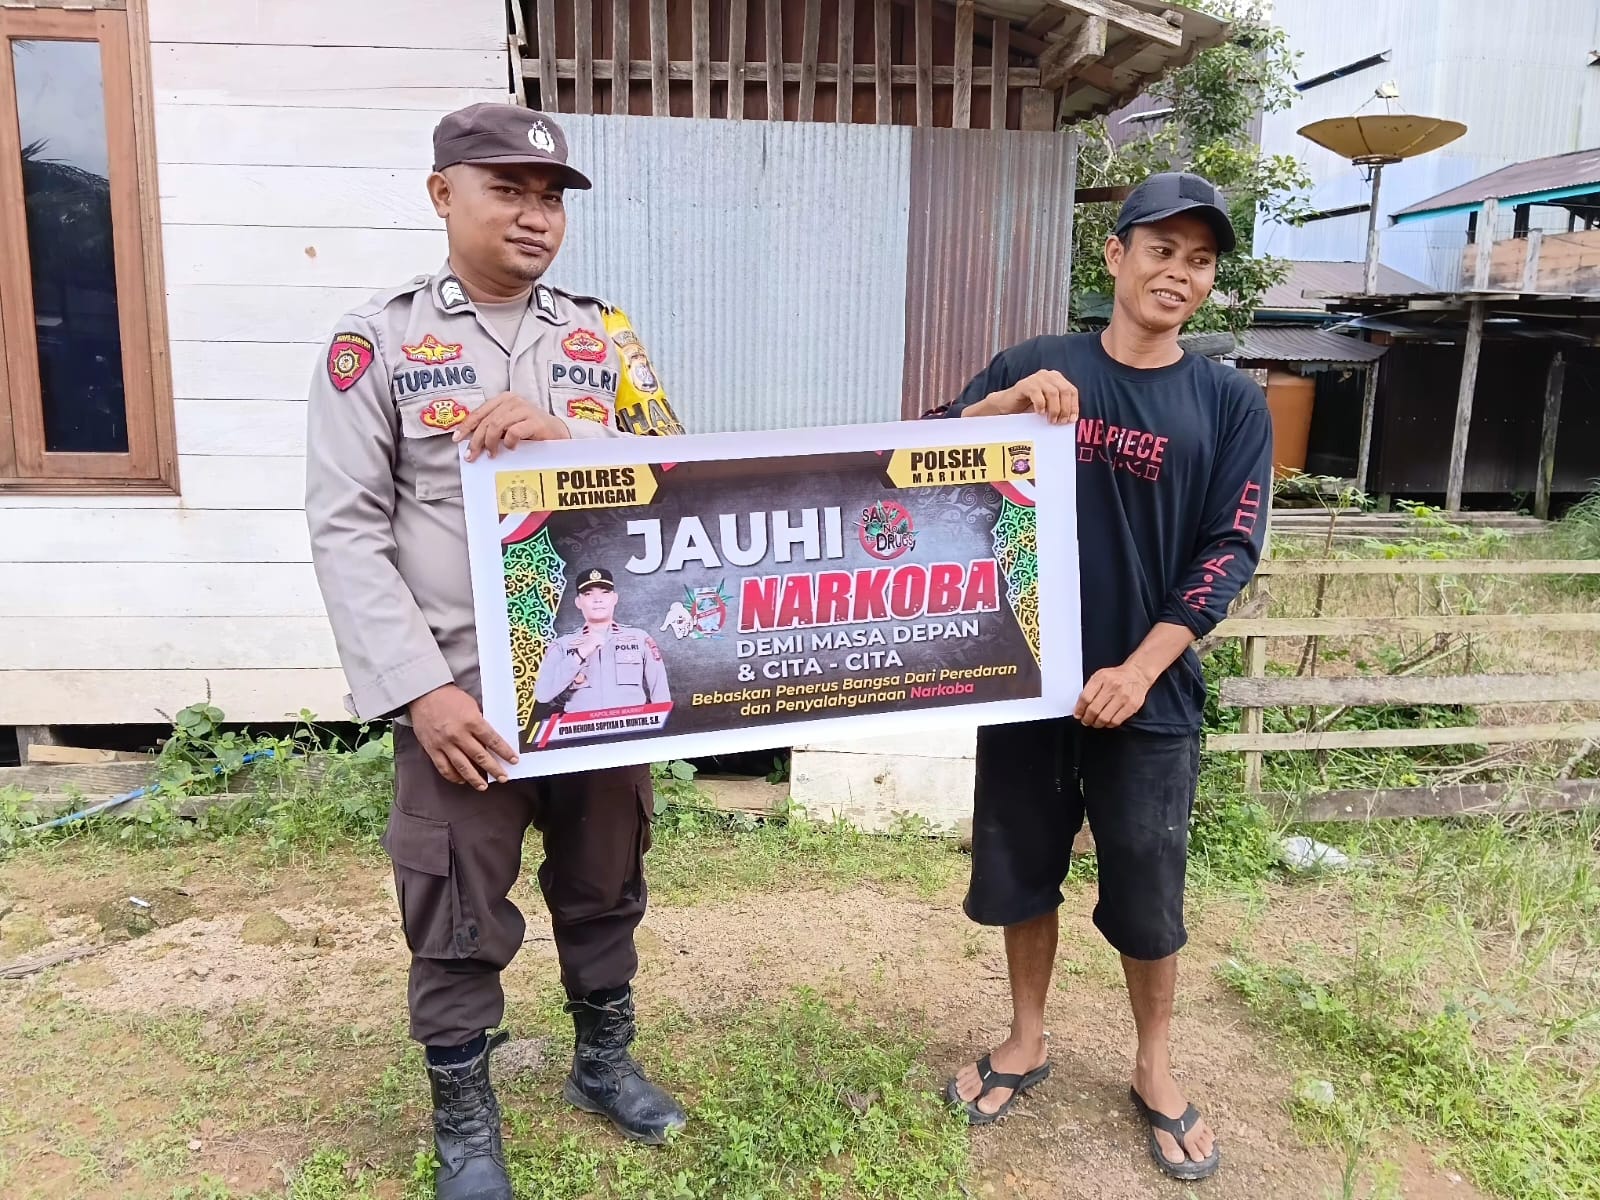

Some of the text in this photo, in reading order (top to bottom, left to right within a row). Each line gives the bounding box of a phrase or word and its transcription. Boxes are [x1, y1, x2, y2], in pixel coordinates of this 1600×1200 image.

[394, 365, 477, 395] TUPANG
[552, 363, 618, 393] POLRI
[910, 447, 988, 472] POLSEK
[1105, 425, 1169, 464] PIECE
[556, 467, 636, 490] POLRES
[912, 468, 988, 484] MARIKIT
[557, 488, 637, 507] KATINGAN
[862, 506, 892, 523] SAY
[624, 506, 844, 575] JAUHI
[876, 532, 915, 551] DRUGS
[737, 558, 1000, 634] NARKOBA
[615, 644, 639, 652] POLRI
[736, 619, 980, 659] DEMI MASA DEPAN
[738, 663, 756, 682] &
[762, 656, 824, 680] CITA
[845, 649, 904, 673] CITA
[691, 664, 1018, 707] Bebaskan Penerus Bangsa Dari Peredaran
[740, 682, 975, 717] dan Penyalahgunaan Narkoba
